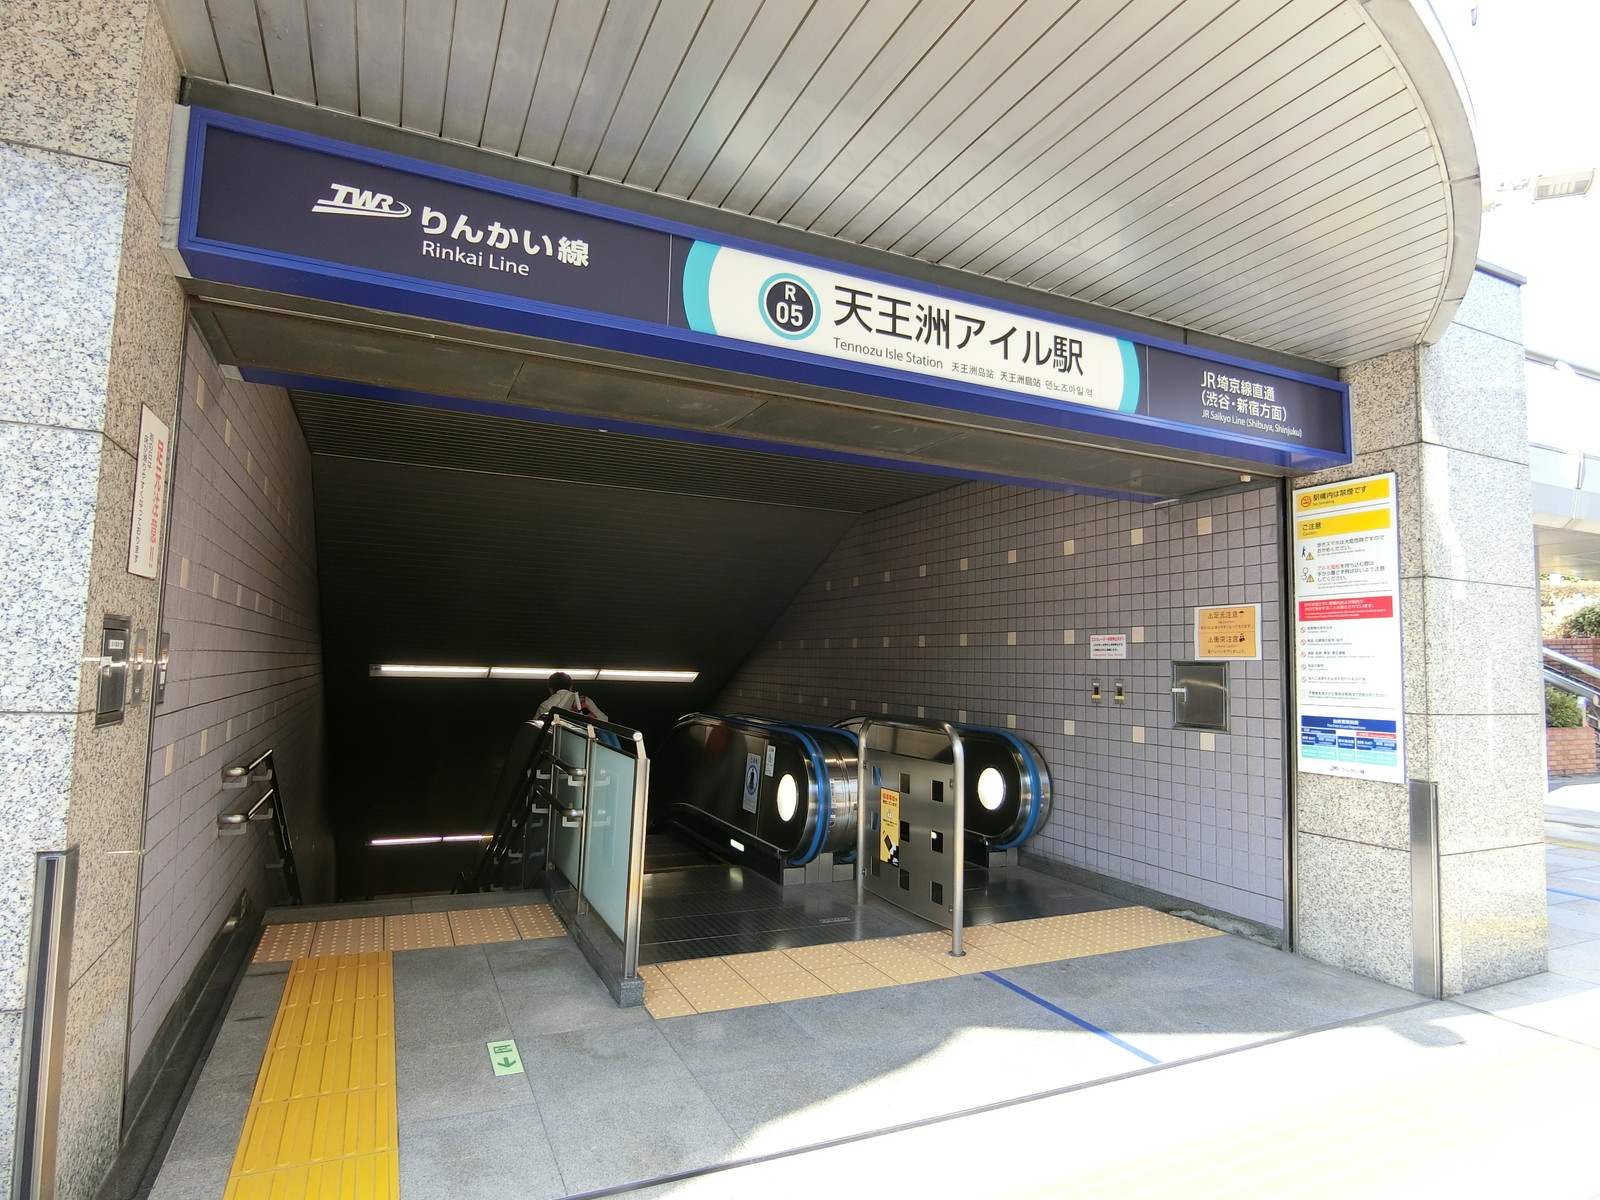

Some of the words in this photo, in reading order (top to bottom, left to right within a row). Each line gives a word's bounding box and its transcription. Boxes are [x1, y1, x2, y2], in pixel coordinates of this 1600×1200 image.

[320, 183, 400, 215] TWR
[421, 206, 590, 267] りんかい線
[422, 240, 483, 267] Rinkai
[489, 253, 530, 276] Line
[784, 284, 796, 302] R
[776, 302, 803, 327] 05
[834, 285, 1084, 377] 天王洲アイル駅
[833, 337, 883, 358] Tennozu
[885, 347, 904, 362] Isle
[906, 351, 944, 370] Station
[1000, 371, 1041, 388] 天王洲島站
[1200, 371, 1275, 402] JR埼京線直通
[1201, 409, 1210, 419] JR
[1210, 410, 1232, 424] Saikyo
[1231, 415, 1246, 427] Line
[1246, 418, 1274, 433] (Shibuya,
[1274, 423, 1303, 438] Shinjuku)
[1313, 485, 1367, 501] 駅構内は禁煙です
[1302, 522, 1321, 531] ご注意
[1214, 611, 1238, 619] 足元注意
[1213, 635, 1238, 643] 衝突注意
